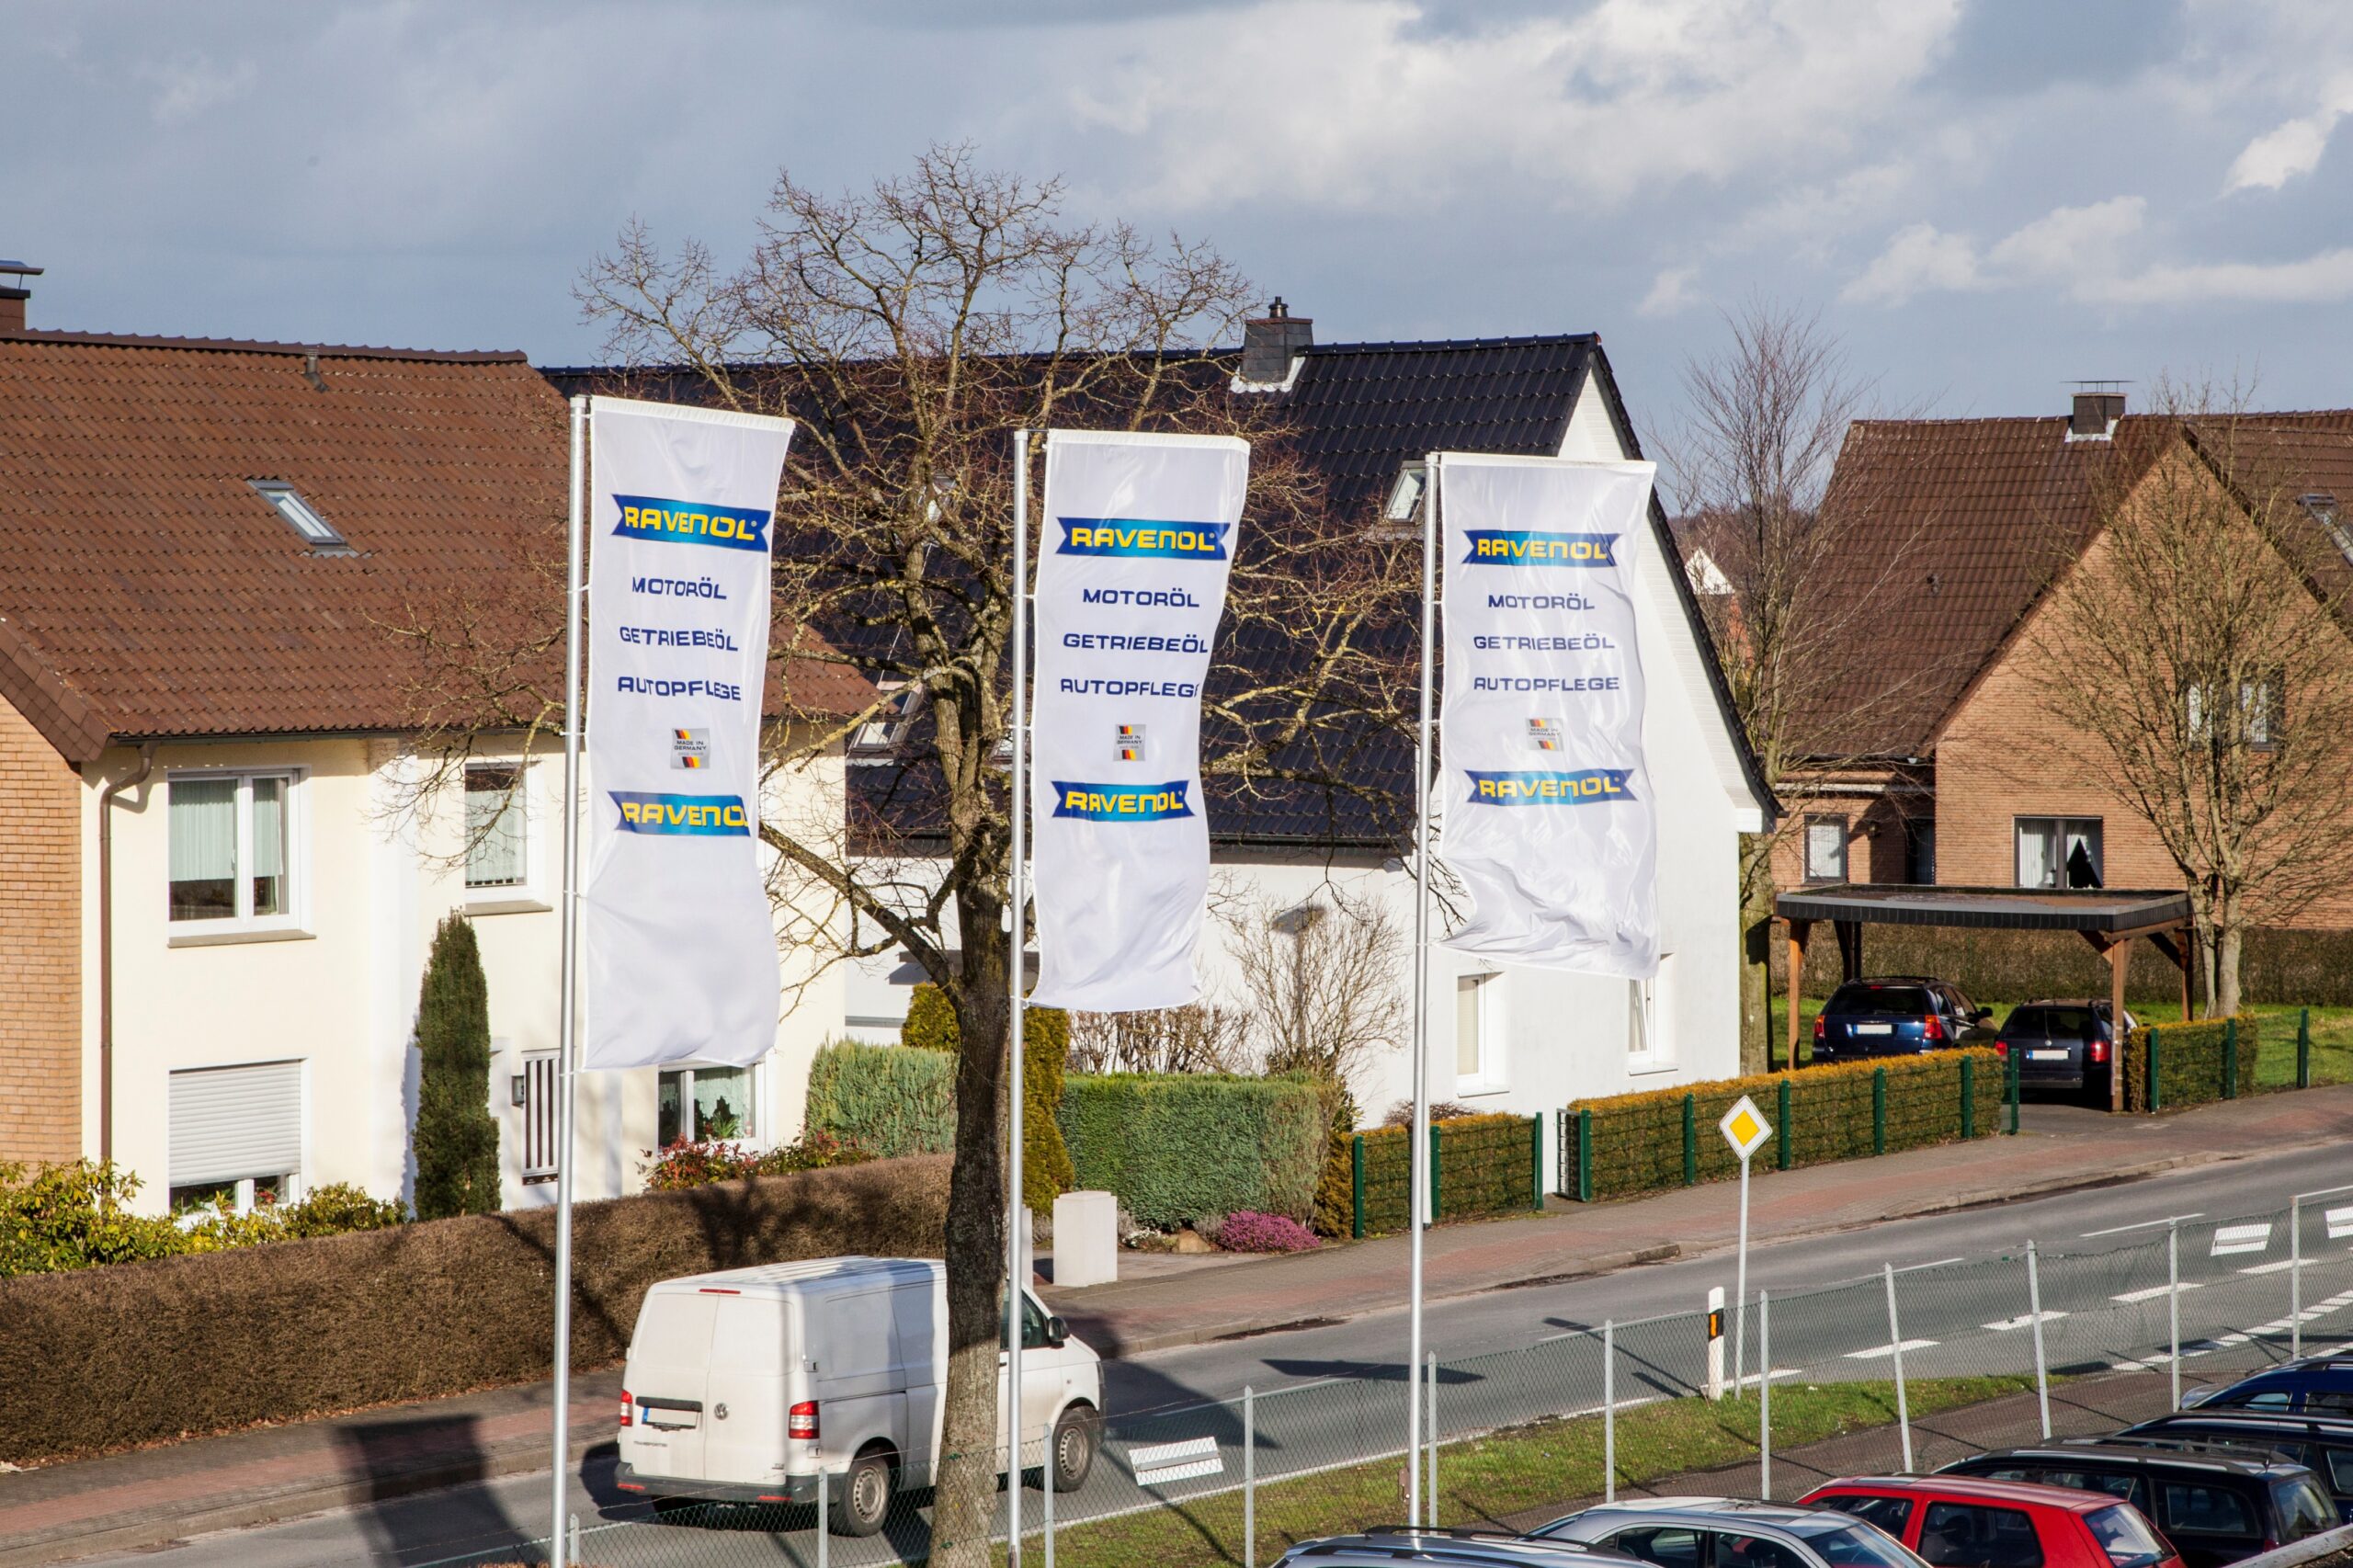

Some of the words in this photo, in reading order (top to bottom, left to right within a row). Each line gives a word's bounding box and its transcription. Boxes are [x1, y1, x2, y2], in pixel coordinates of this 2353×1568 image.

[624, 506, 756, 541] RAVENOL
[1071, 527, 1216, 551] RAVENOL
[1477, 539, 1608, 560] RAVENOL
[631, 576, 727, 600] MOTORÖL
[1083, 587, 1199, 608] MOTORÖL
[1488, 593, 1596, 611] MOTORÖL
[620, 626, 739, 652] GETRIEBEÖL
[1063, 633, 1209, 653] GETRIEBEÖL
[1473, 633, 1616, 651] GETRIEBEÖL
[618, 676, 742, 701] AUTOPFLEGE
[1061, 678, 1199, 699] AUTOPFLEG
[1473, 676, 1620, 691] AUTOPFLEGE
[1478, 777, 1621, 798] RAVENOL
[1065, 790, 1184, 813] RAVENOL
[621, 801, 749, 827] RAVENO
